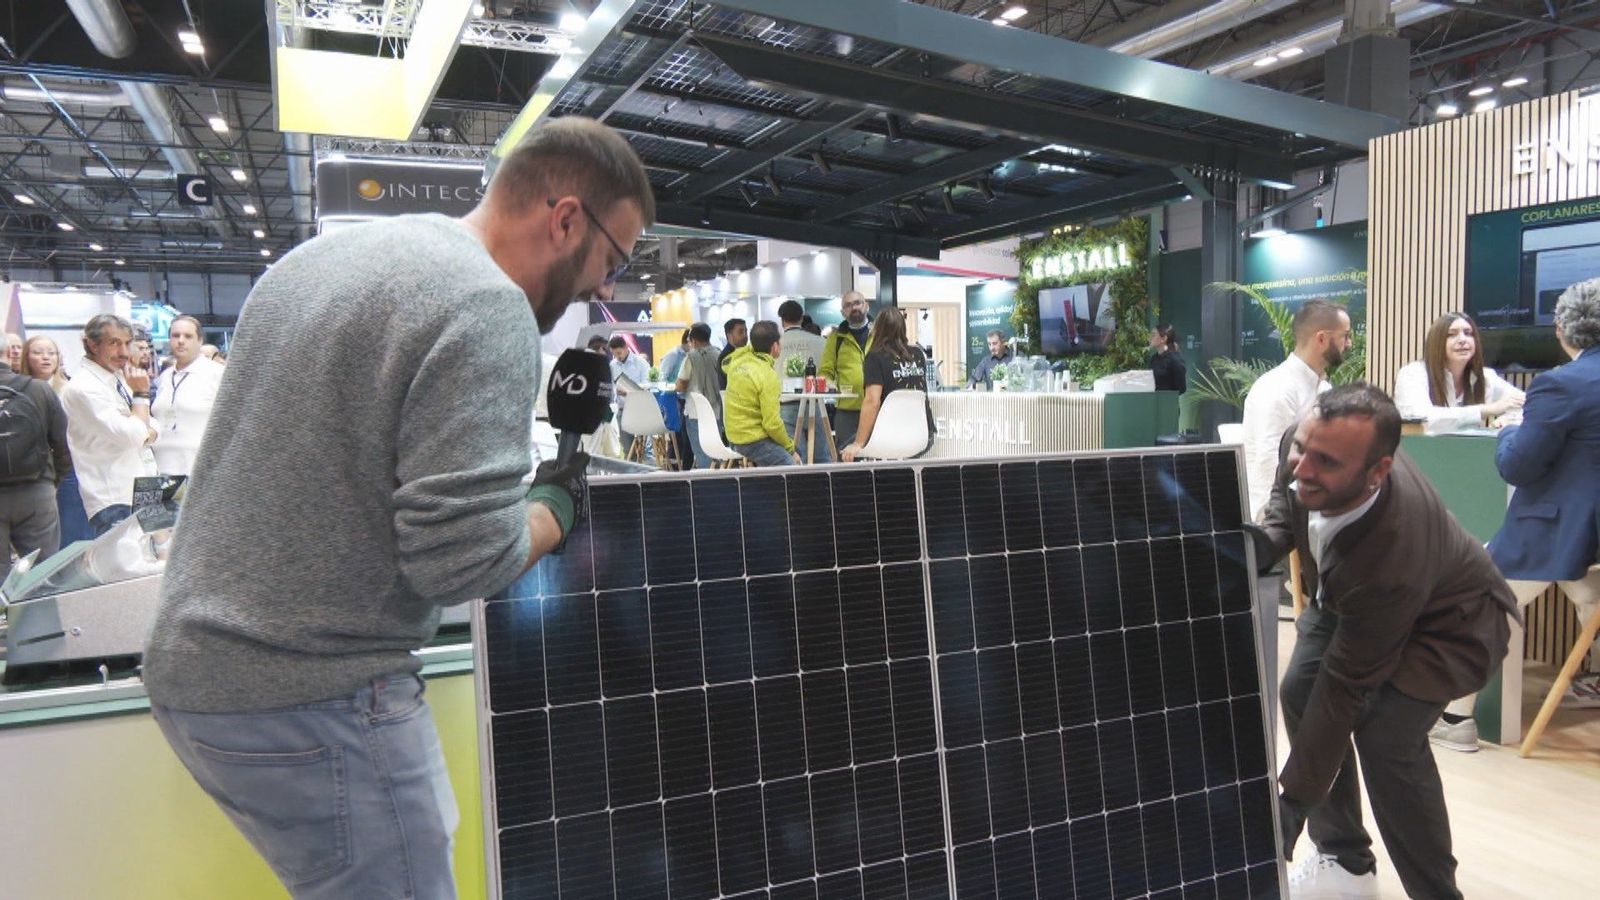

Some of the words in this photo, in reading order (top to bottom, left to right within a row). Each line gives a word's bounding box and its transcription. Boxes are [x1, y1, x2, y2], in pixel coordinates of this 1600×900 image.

[186, 179, 207, 202] C
[1031, 242, 1132, 281] ENSTALL
[551, 370, 588, 395] MD
[936, 416, 1031, 446] ENSTALL
